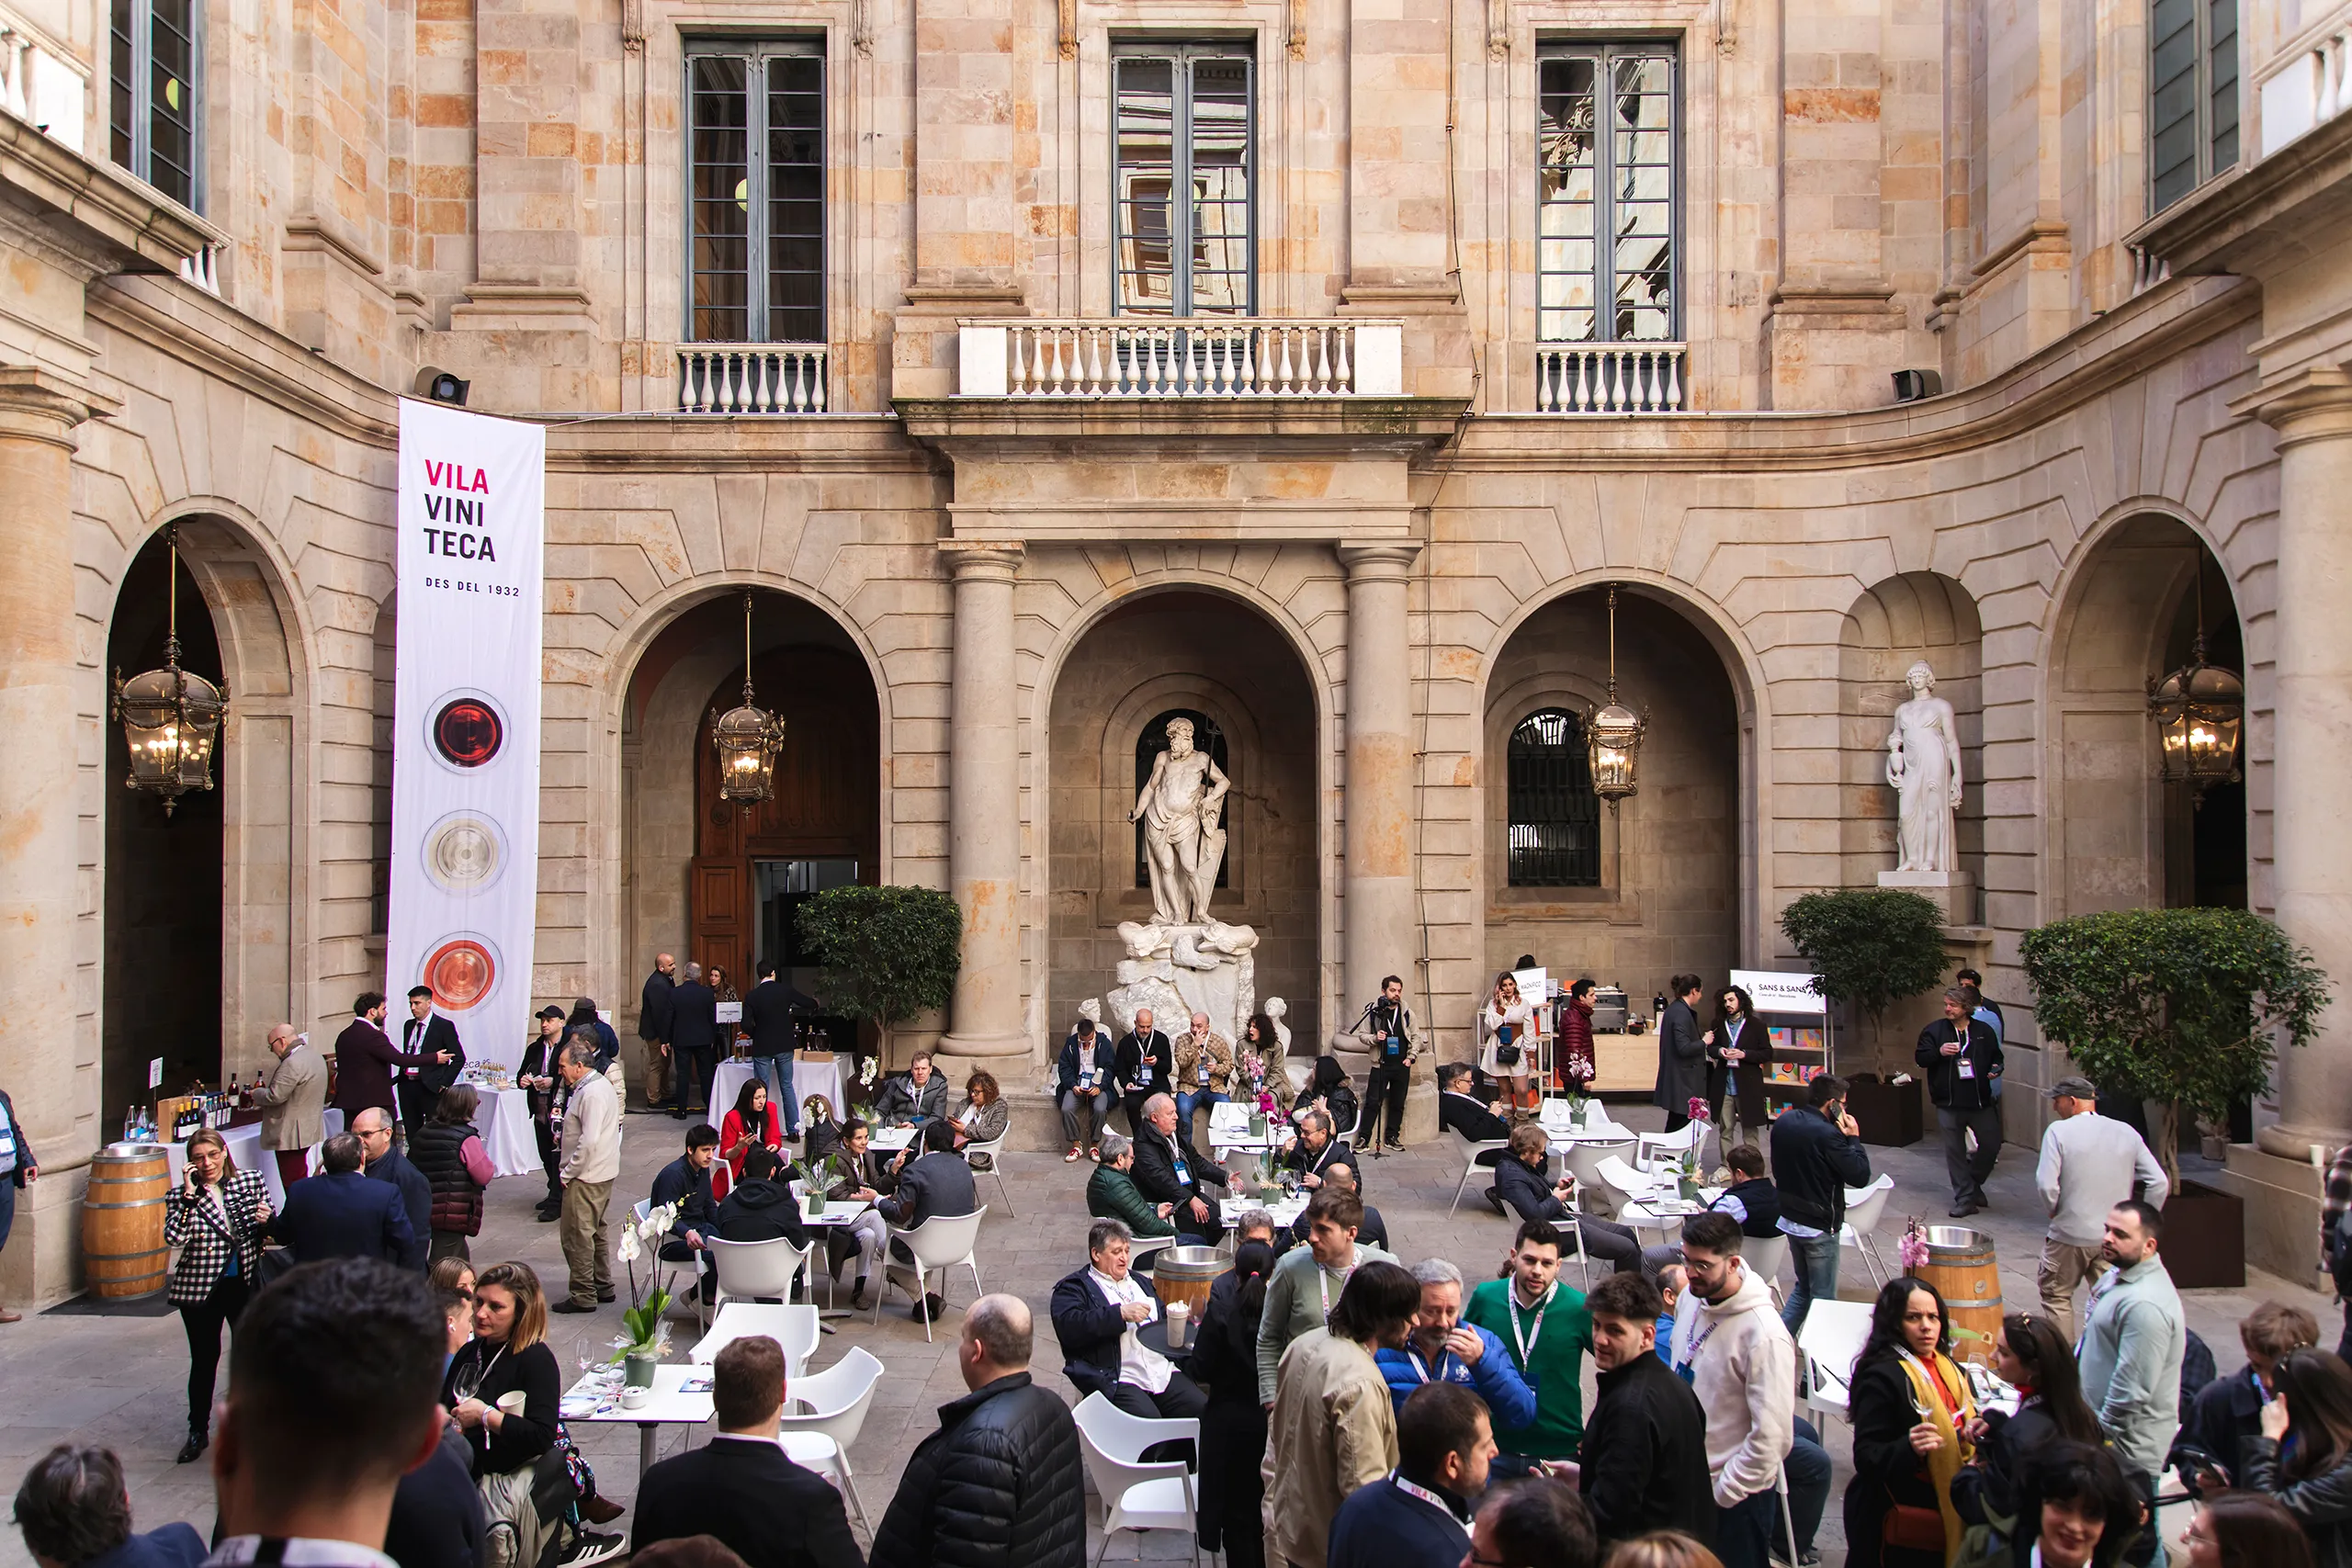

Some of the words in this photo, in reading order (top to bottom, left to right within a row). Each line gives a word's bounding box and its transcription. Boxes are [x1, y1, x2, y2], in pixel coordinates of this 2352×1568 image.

[424, 459, 490, 495] VILA
[424, 493, 484, 527] VINI
[424, 527, 496, 563] TECA
[425, 577, 450, 589] DES
[457, 581, 480, 592] DEL
[488, 584, 520, 597] 1932
[1758, 984, 1779, 992] SANS
[1786, 986, 1806, 994] SANS
[463, 1060, 480, 1069] eca
[1698, 1321, 1719, 1344] VINITECA
[1410, 1484, 1428, 1499] VILA
